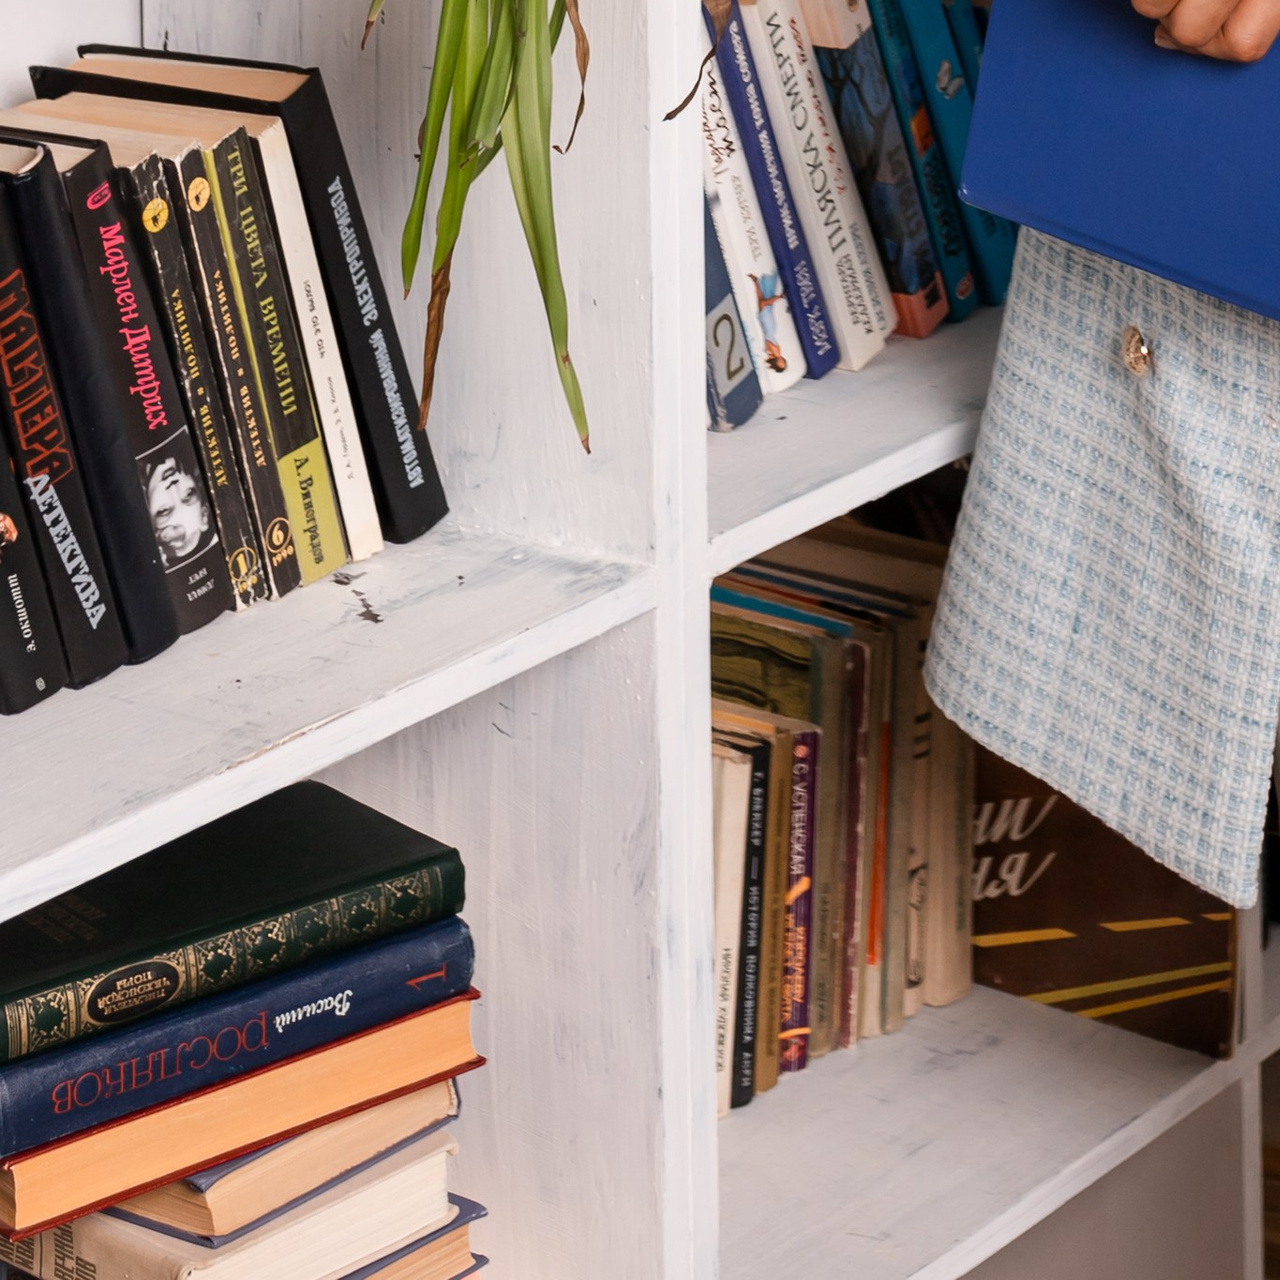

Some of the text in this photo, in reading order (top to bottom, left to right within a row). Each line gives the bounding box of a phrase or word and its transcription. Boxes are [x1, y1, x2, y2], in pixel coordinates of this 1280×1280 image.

[766, 12, 848, 255] ПЛЯСКА СМЕРТИ
[99, 220, 169, 431] Марлен Дитрих
[212, 269, 240, 362] ПОЛИТИКА
[227, 143, 299, 418] ТРИ ЦВЕТА ВРЕМЕНИ
[326, 174, 427, 489] АВТОМАТИЗИРОВАННЫЙ ЭЛЕКТРОПРИВОД
[170, 287, 201, 381] ПОЛИТИКА
[712, 312, 746, 382] 2
[199, 403, 230, 487] ДЕТЕКТИВ
[238, 384, 268, 469] ДЕТЕКТИВ
[22, 471, 108, 631] ДЕТЕКТИВА
[293, 455, 326, 566] А. Виноградов
[785, 781, 812, 877] УСПЕНСКАЯ
[404, 962, 447, 991] 1
[51, 989, 353, 1115] Василий РОСЛЯКОВ
